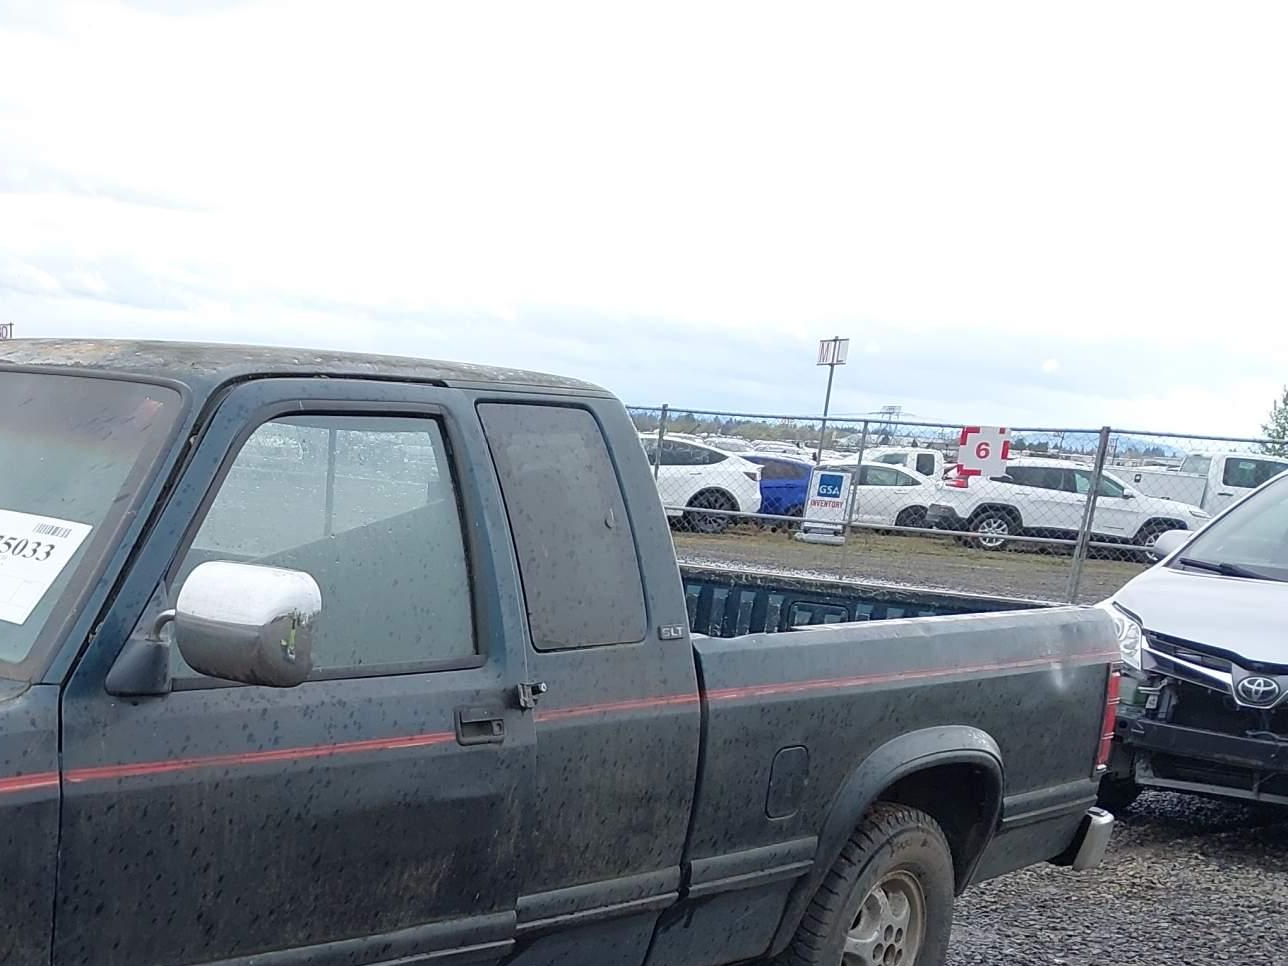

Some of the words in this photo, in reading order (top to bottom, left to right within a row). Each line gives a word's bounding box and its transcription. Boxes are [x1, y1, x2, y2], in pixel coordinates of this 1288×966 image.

[975, 441, 990, 459] 6
[819, 485, 839, 495] GSA
[810, 499, 843, 508] INVENTORY
[662, 626, 684, 637] SLT
